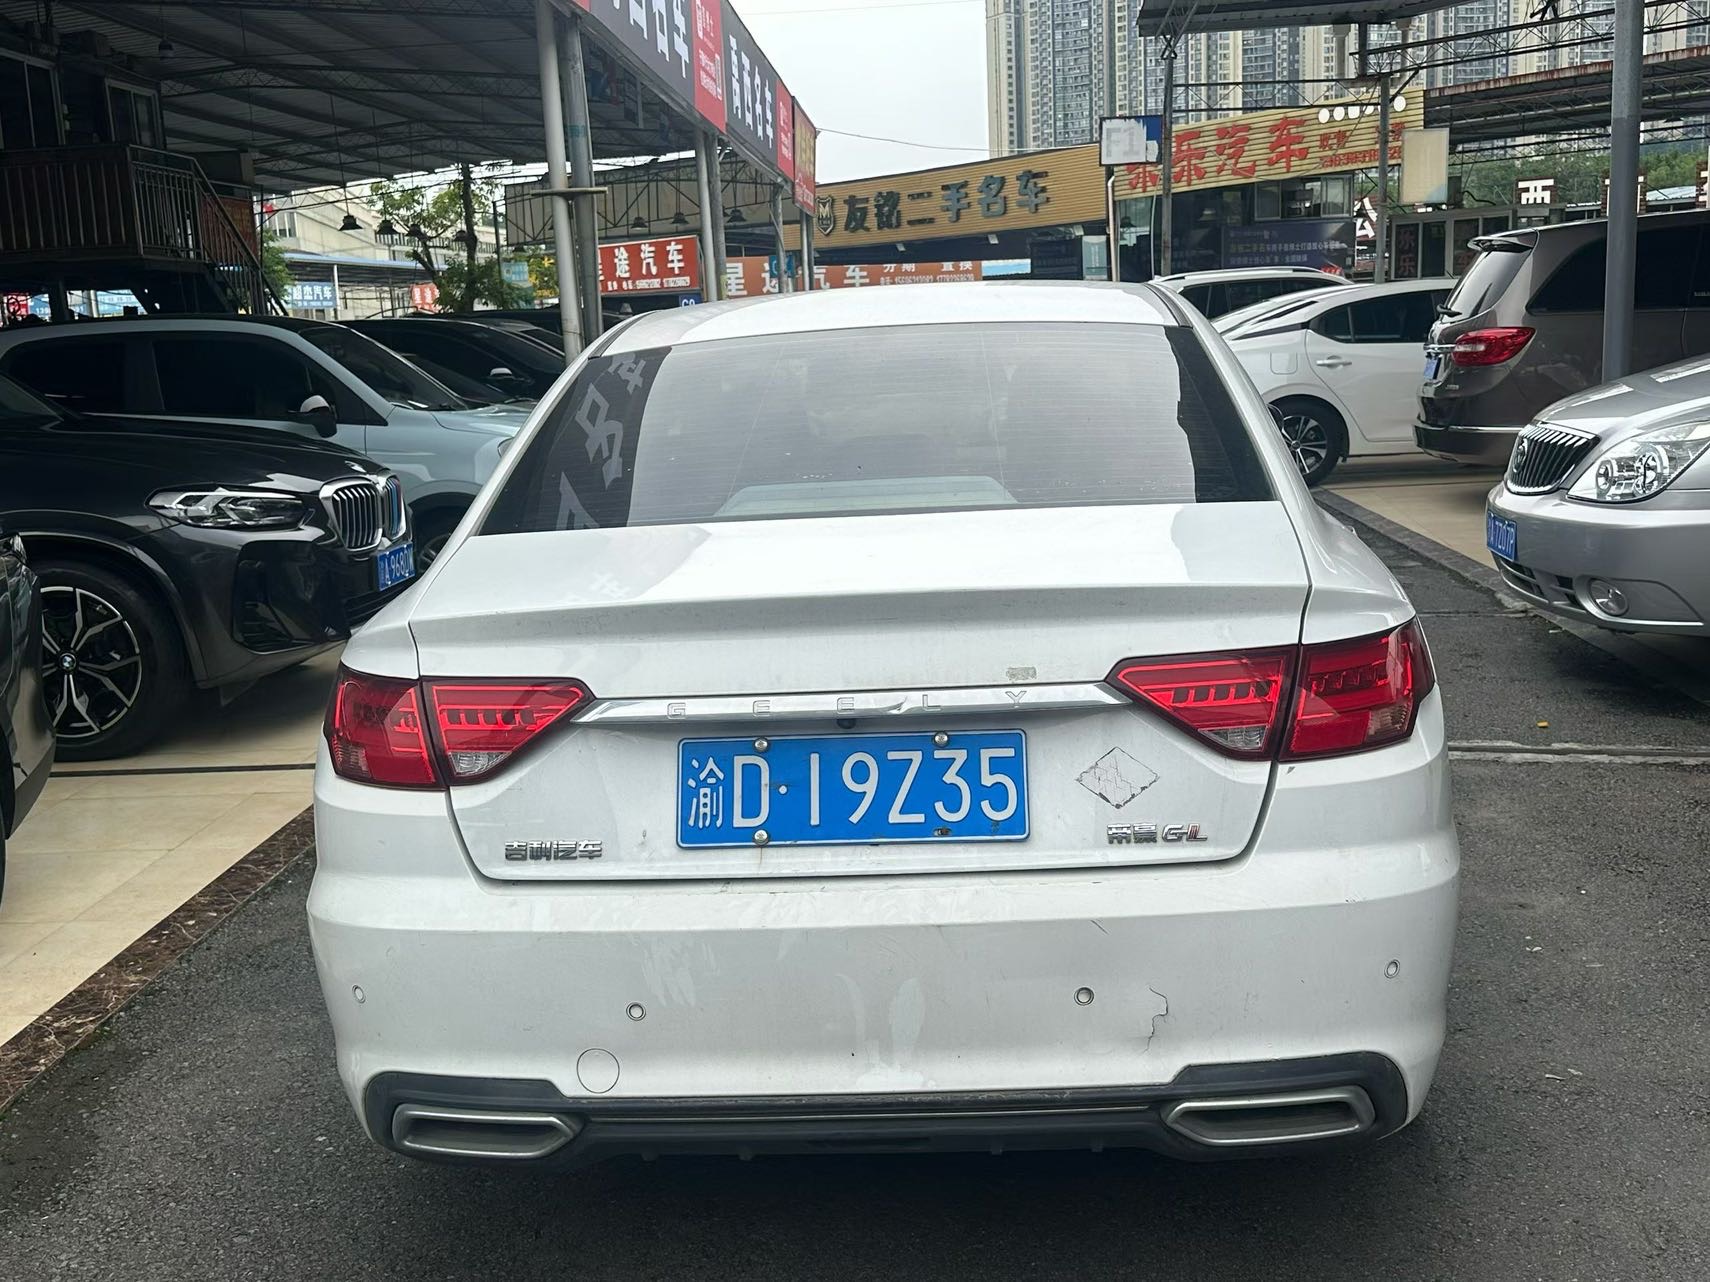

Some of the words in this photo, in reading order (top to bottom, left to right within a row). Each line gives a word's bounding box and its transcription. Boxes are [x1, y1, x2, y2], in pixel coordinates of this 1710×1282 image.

[666, 690, 1027, 720] GEELY
[504, 840, 603, 861] 吉利汽车
